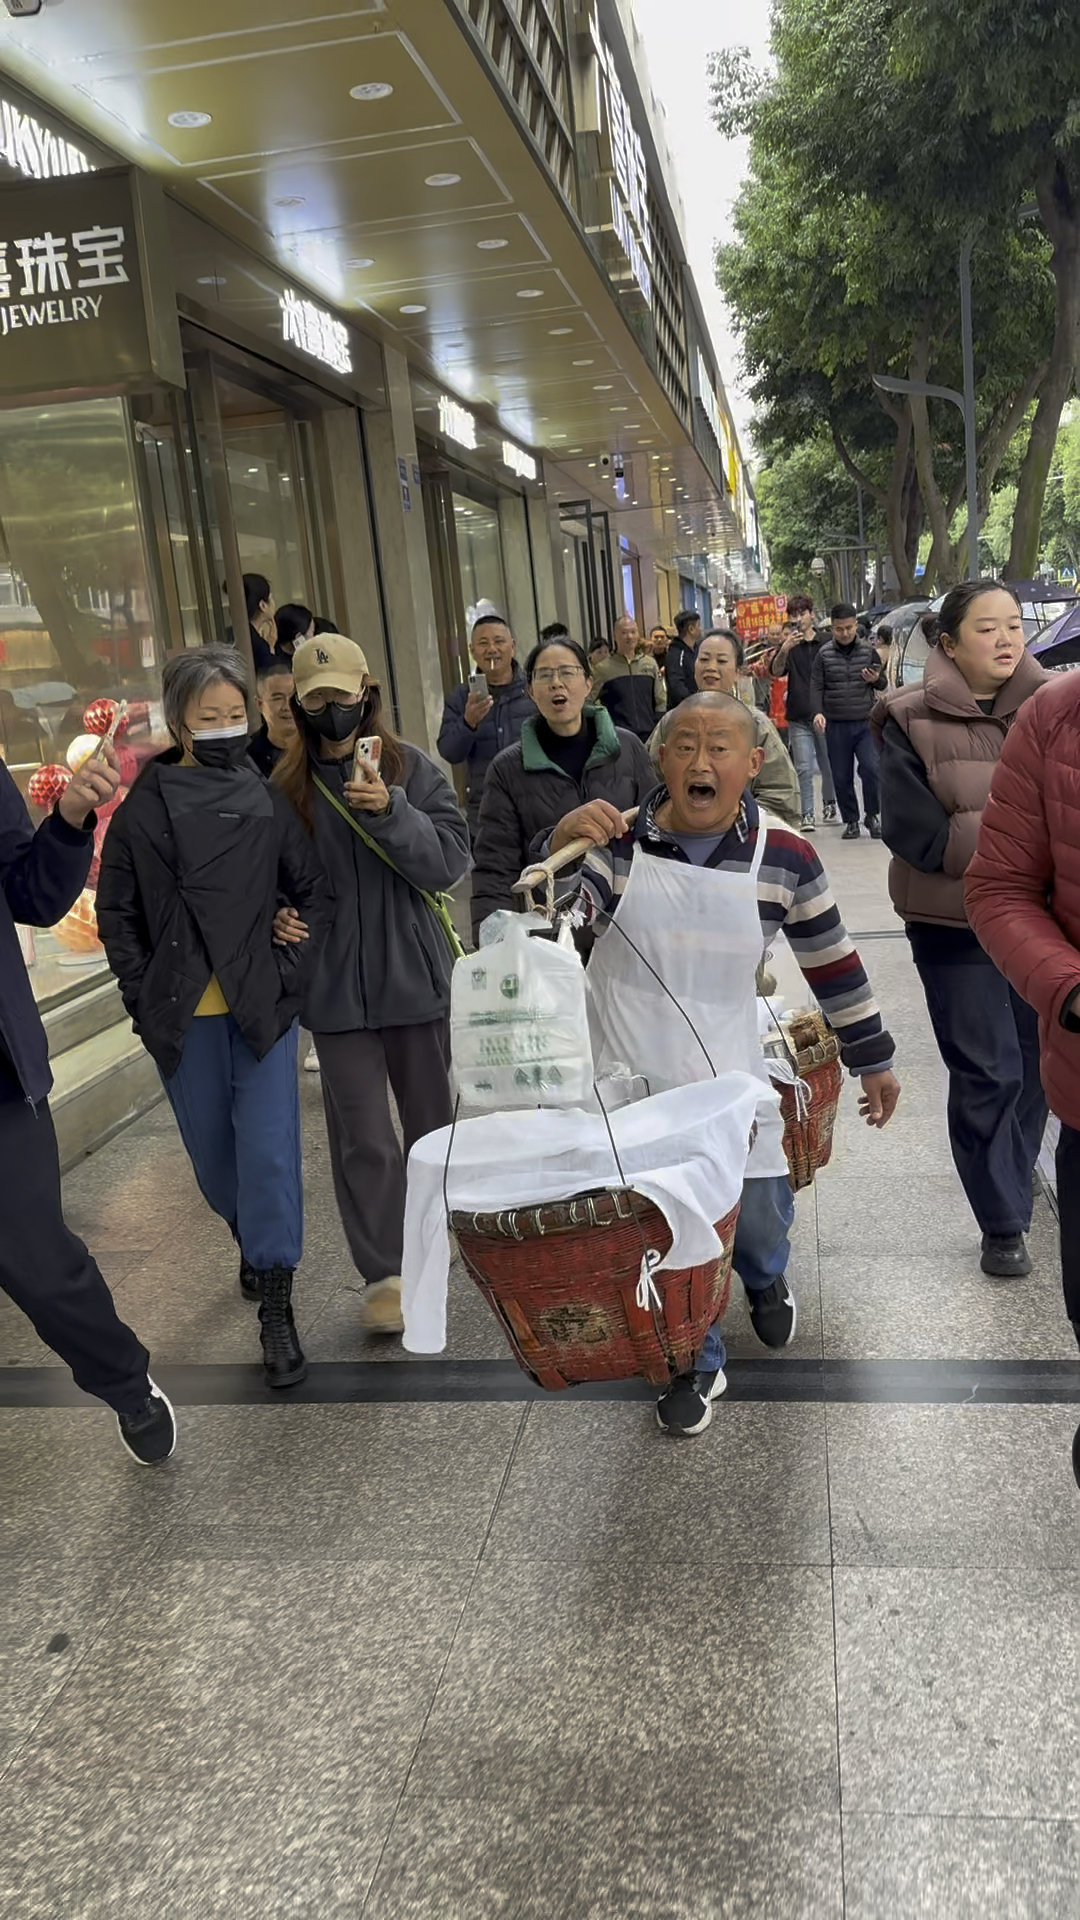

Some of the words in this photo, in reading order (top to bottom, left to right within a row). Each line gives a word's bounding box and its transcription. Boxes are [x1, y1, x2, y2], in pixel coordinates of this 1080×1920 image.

[0, 225, 130, 298] 珠宝
[0, 295, 103, 336] JEWELRY
[315, 648, 329, 665] LA
